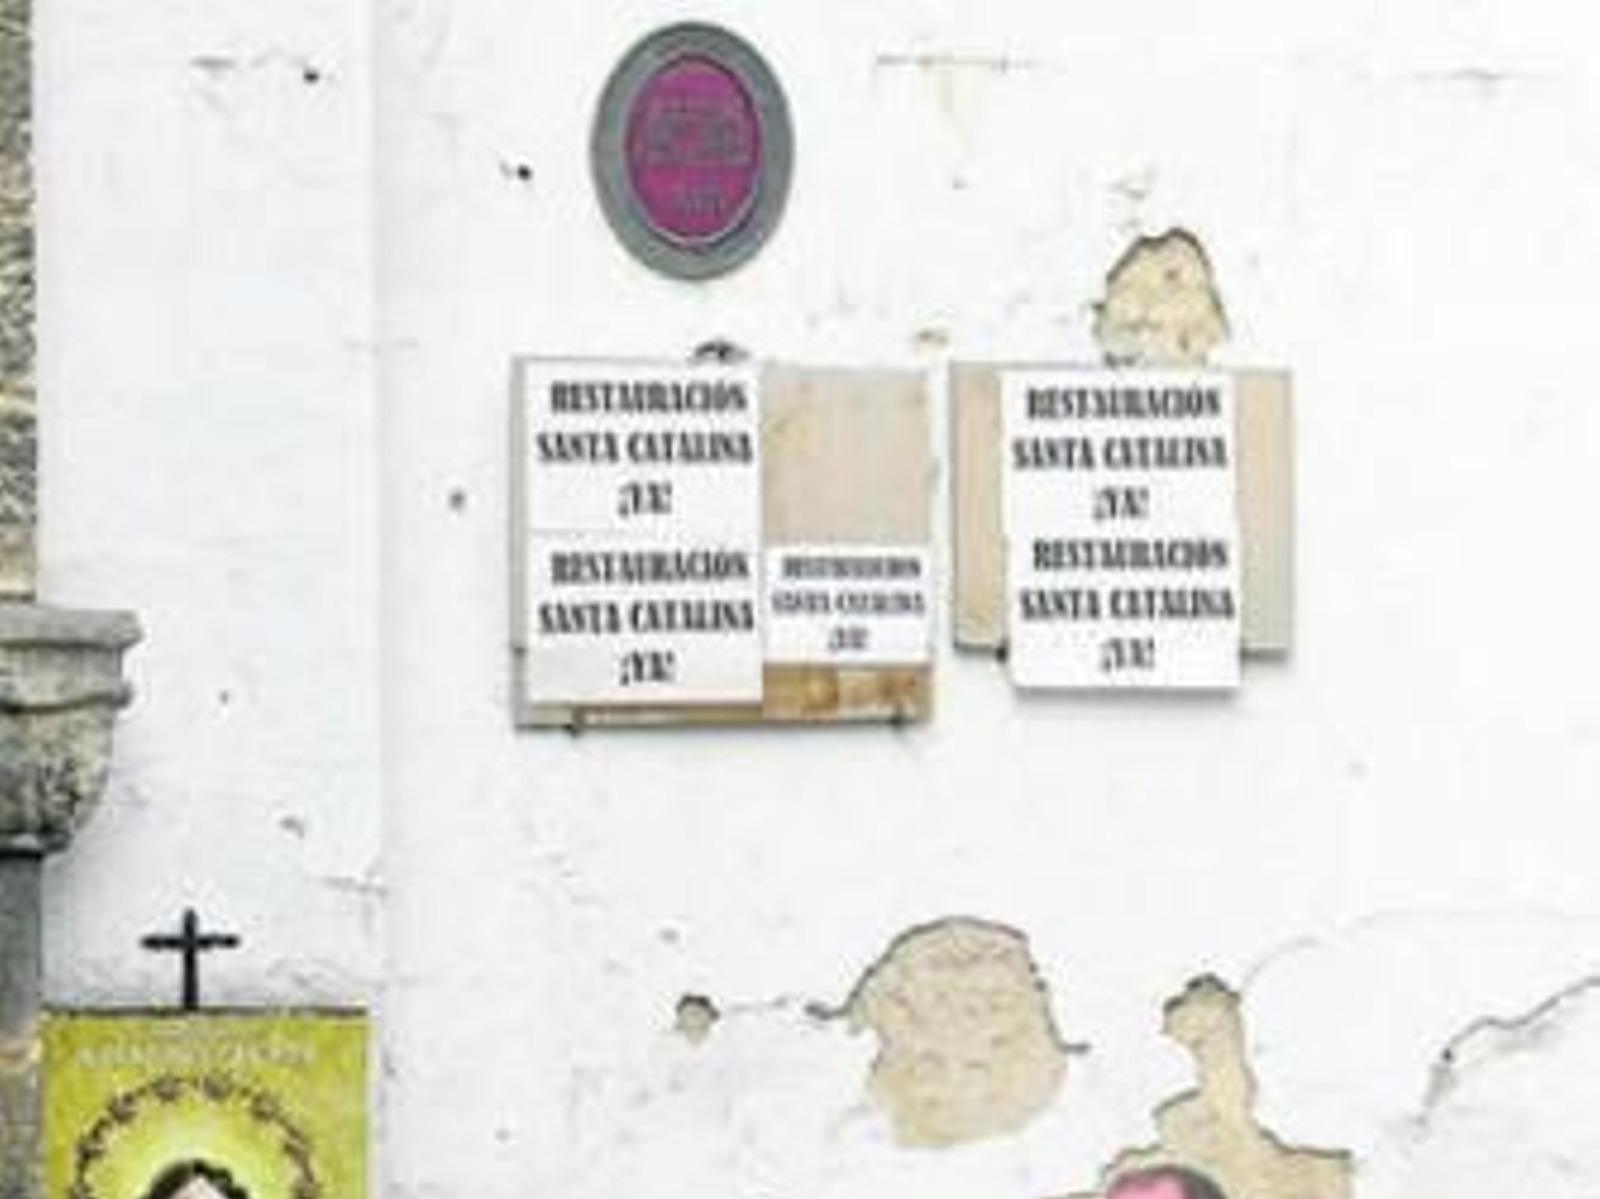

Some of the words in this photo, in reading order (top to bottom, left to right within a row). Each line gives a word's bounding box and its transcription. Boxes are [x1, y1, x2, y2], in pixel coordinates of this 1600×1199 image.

[536, 431, 620, 464] SANTA
[626, 430, 754, 465] CATALINA
[1012, 436, 1096, 471] SANTA
[1102, 436, 1228, 470] CATALINA
[537, 601, 622, 636] SANTA
[628, 599, 755, 634] CATALINA
[1019, 588, 1102, 621] SANTA
[1109, 587, 1236, 621] CATALINA
